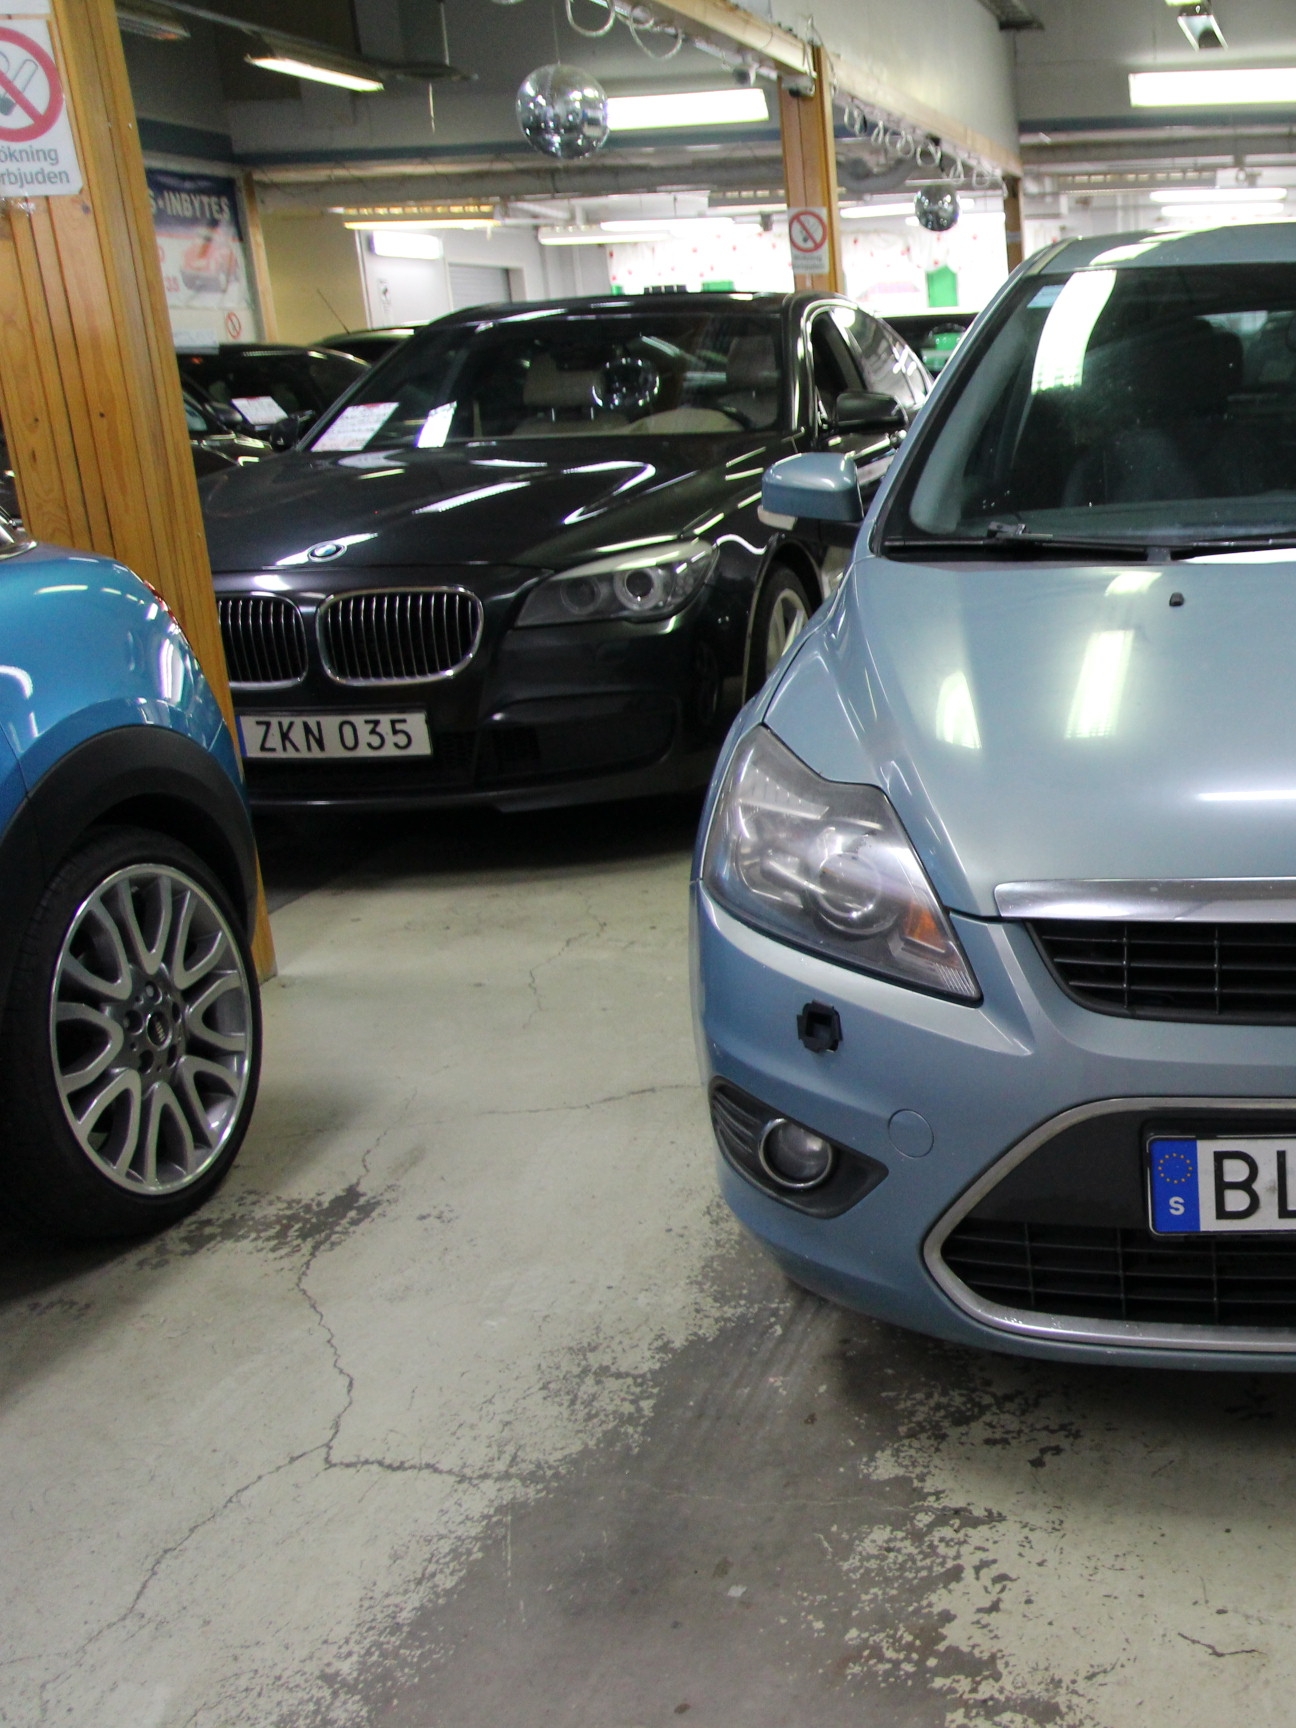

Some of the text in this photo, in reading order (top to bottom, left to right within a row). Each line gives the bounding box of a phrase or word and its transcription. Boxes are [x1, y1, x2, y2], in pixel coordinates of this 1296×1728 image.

[0, 144, 59, 166] ökning
[0, 167, 70, 188] rbjuden
[255, 718, 413, 752] ZKN 035
[1168, 1196, 1185, 1216] S
